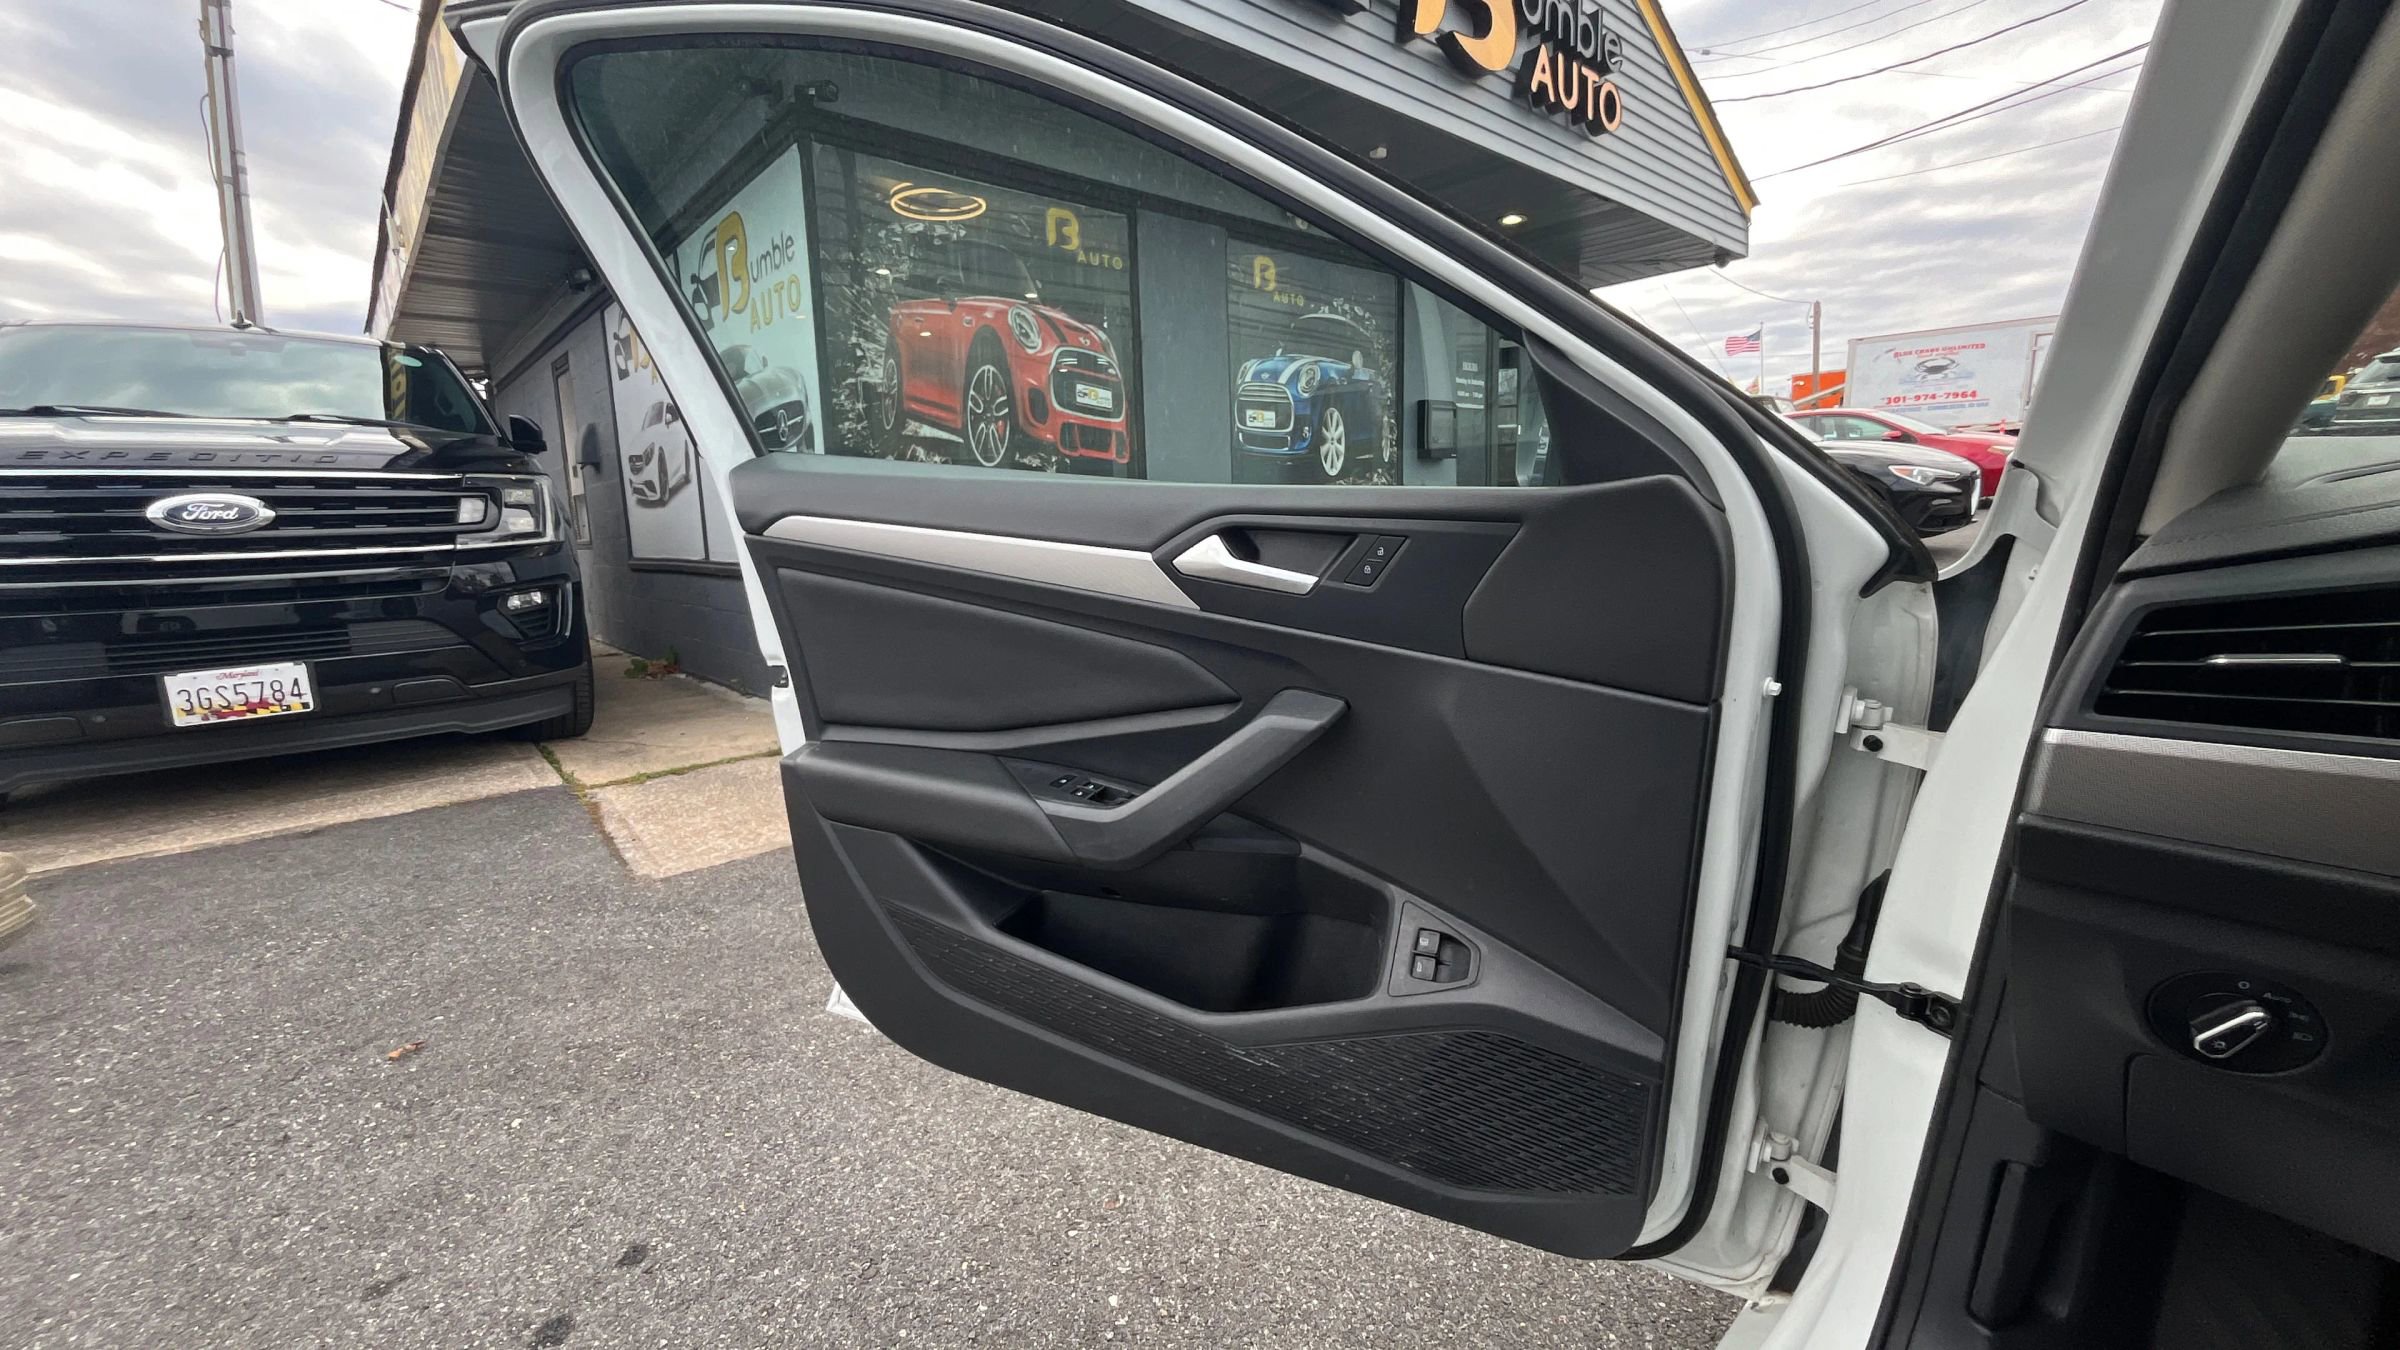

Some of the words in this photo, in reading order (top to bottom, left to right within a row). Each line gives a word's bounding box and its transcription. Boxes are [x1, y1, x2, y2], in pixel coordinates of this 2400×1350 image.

[1531, 43, 1622, 132] AUTO
[1077, 249, 1123, 270] AUTO
[750, 273, 801, 334] AUTO
[1272, 291, 1304, 307] AUTO
[1886, 390, 1978, 405] 301-974-7964
[182, 502, 239, 520] Ford
[215, 669, 261, 681] Maryland
[176, 677, 307, 713] 3GS5784
